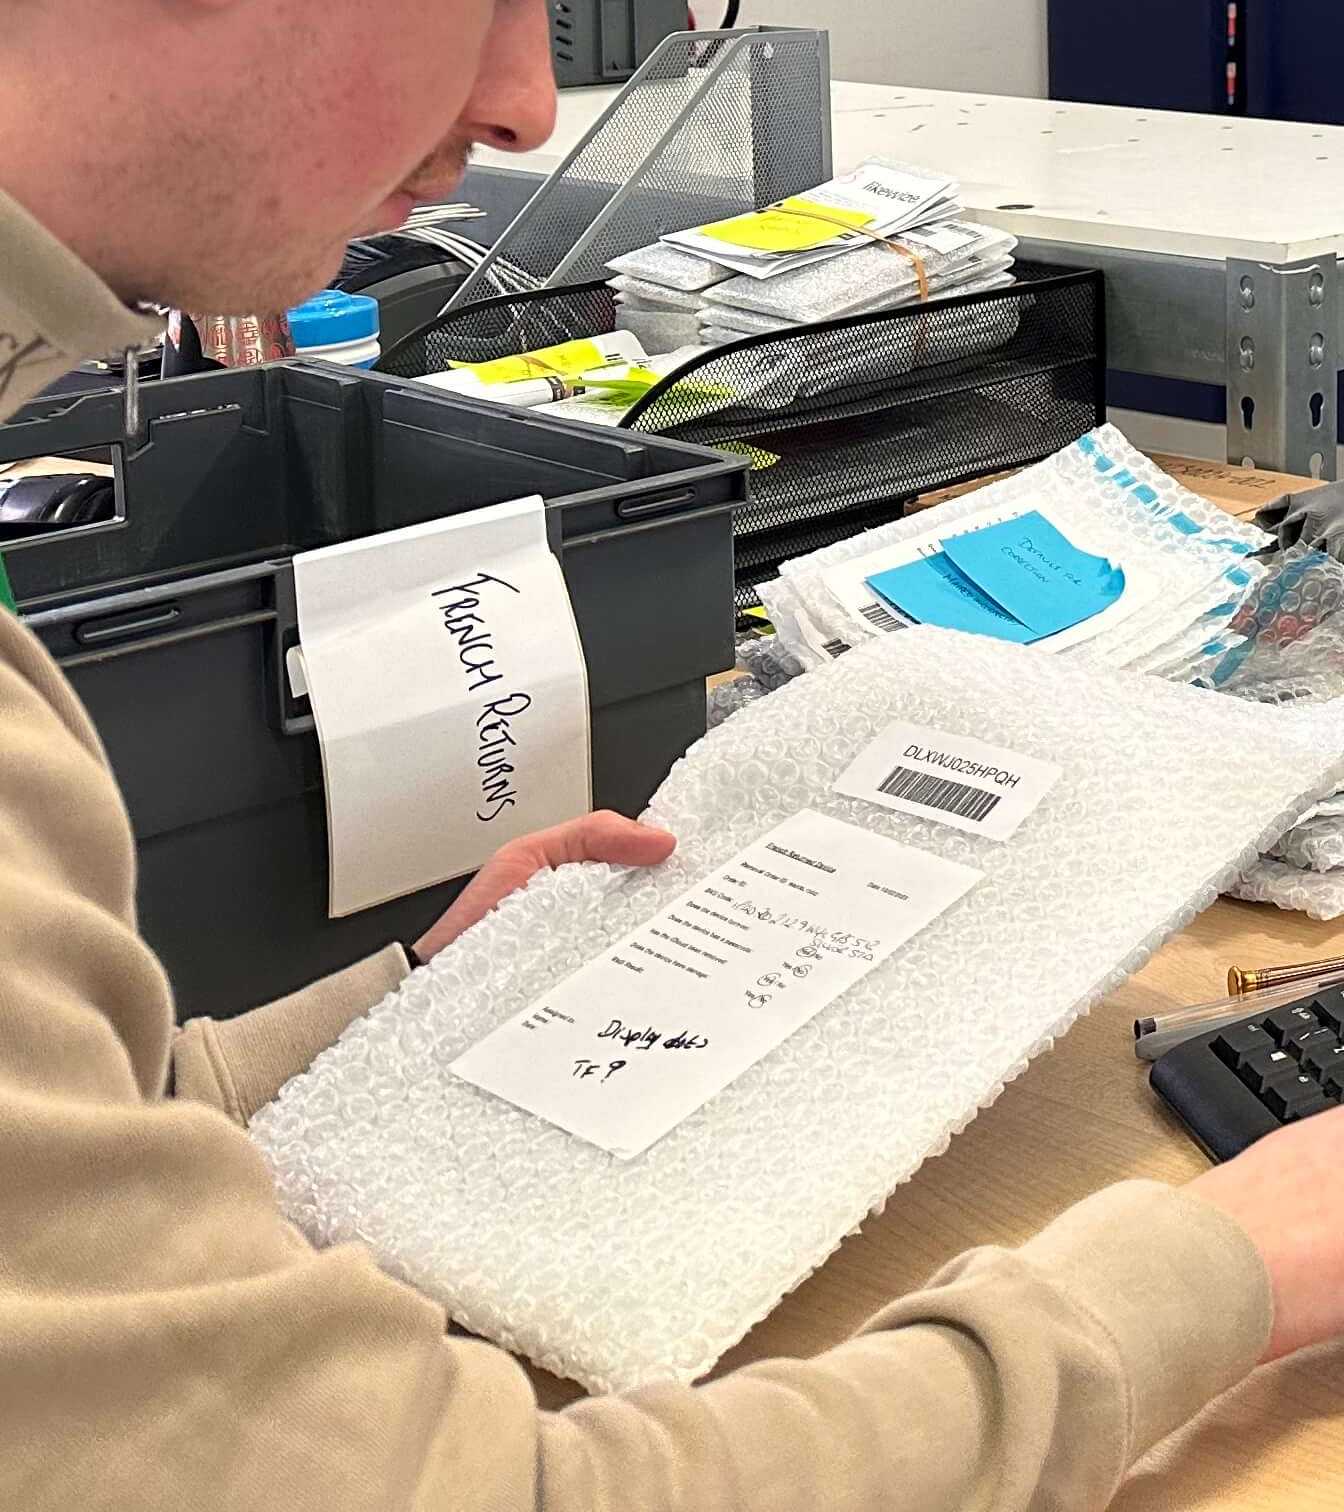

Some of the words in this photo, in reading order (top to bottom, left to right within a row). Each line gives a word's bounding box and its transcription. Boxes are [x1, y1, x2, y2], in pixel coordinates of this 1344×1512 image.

[431, 572, 520, 692] FRENCH
[476, 692, 532, 822] RETURNS
[903, 744, 1021, 789] DLXWJ025HPQH
